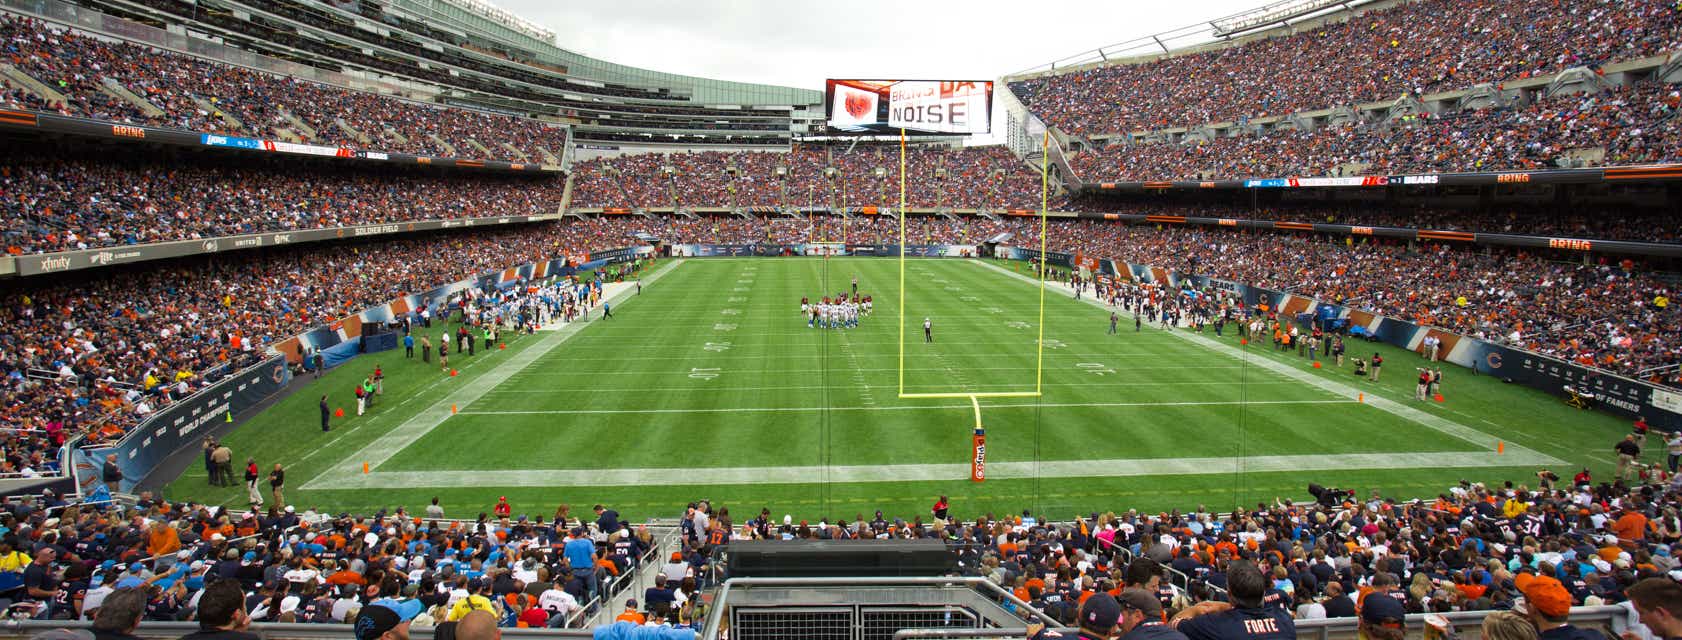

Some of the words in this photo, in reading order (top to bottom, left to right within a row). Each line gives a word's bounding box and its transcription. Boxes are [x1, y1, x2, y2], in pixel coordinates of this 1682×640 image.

[893, 102, 966, 124] NOISE
[112, 125, 144, 138] BRING
[1403, 176, 1438, 184] BEARS
[1498, 174, 1529, 183] BRING
[355, 226, 381, 236] SOLDIER
[382, 225, 399, 233] FIELD
[1549, 239, 1592, 250] BRING
[41, 256, 71, 272] xfinity
[1209, 280, 1235, 291] BEARS
[1595, 393, 1606, 401] OF
[1606, 396, 1640, 412] FAMERS
[179, 418, 200, 437] WORLD
[200, 402, 230, 425] CHAMPIONS
[1522, 519, 1541, 537] 34
[1244, 618, 1279, 633] FORTE
